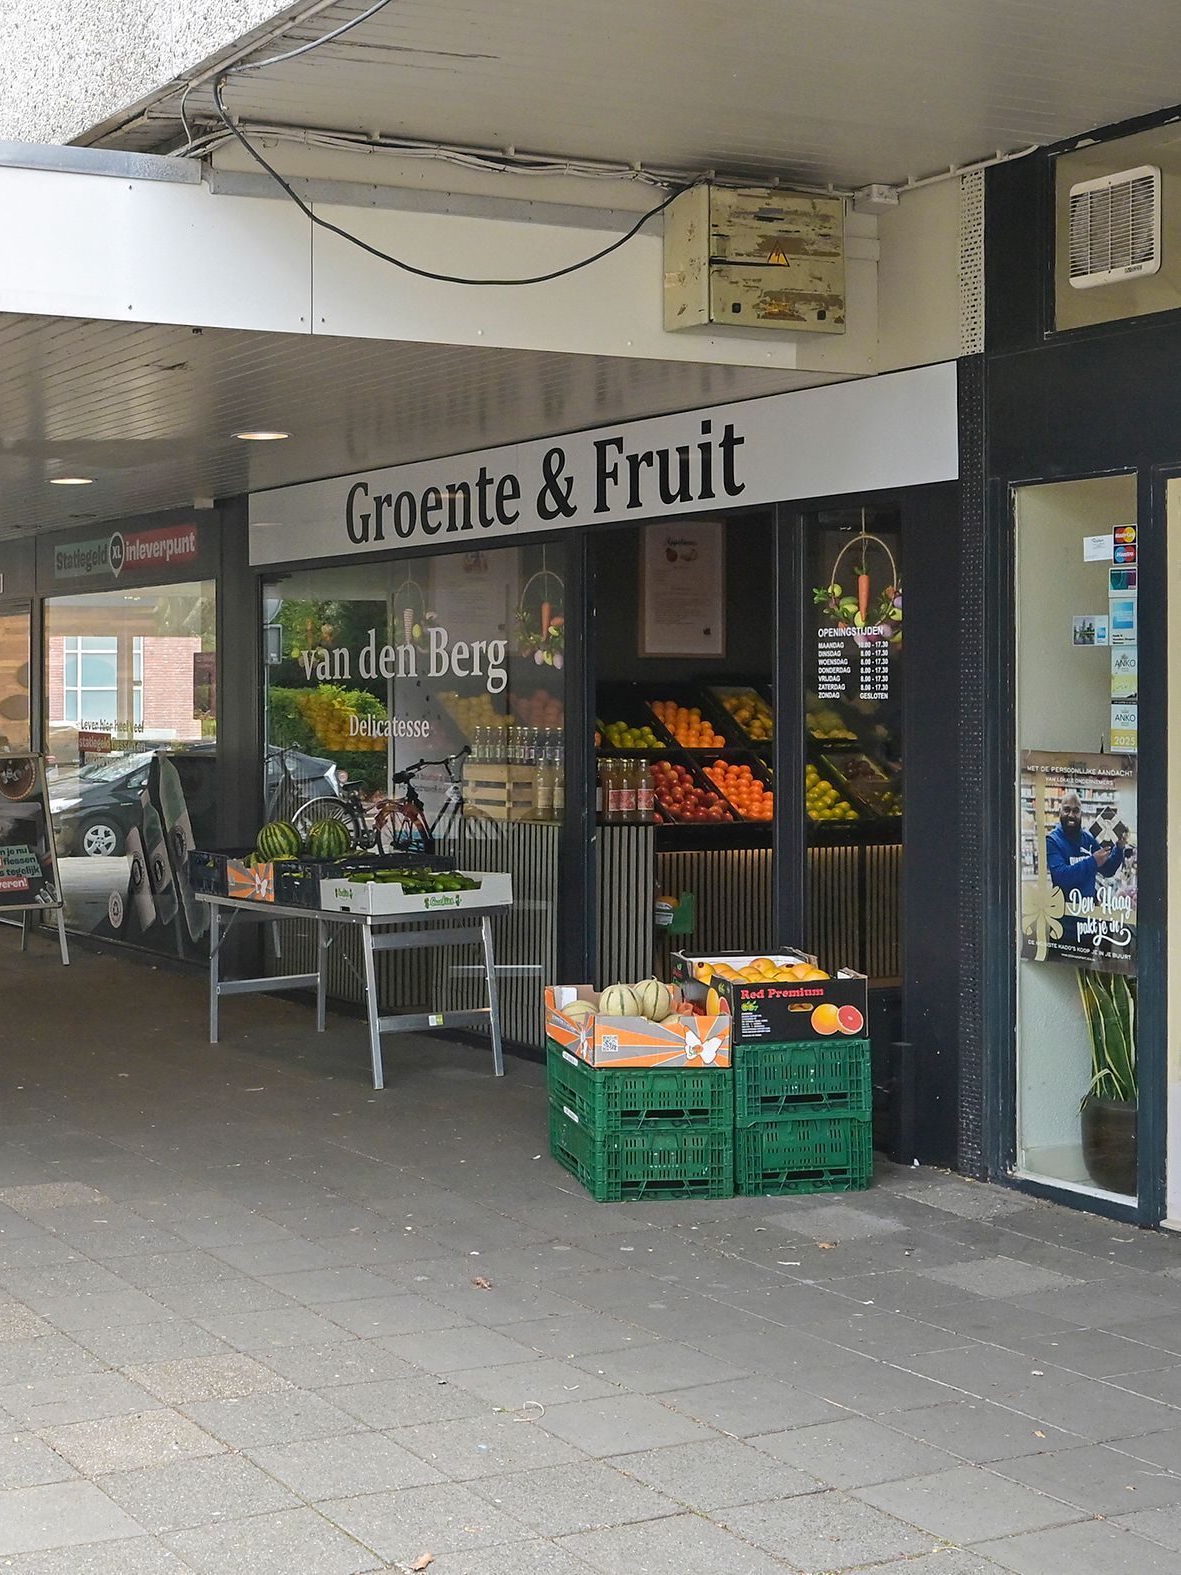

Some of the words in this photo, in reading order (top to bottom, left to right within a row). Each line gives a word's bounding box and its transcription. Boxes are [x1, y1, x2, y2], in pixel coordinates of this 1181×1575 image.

[346, 467, 520, 545] Groente
[536, 447, 578, 521] &
[593, 419, 746, 514] Fruit
[56, 545, 108, 573] Statiegeld
[111, 545, 122, 560] XL
[125, 531, 196, 561] inleverpunt
[818, 626, 884, 637] OPENINGSTIJDEN
[301, 646, 352, 681] van
[359, 628, 418, 680] den
[427, 627, 509, 694] Berg
[1114, 660, 1136, 668] ANKO
[1114, 714, 1136, 722] ANKO
[349, 714, 430, 738] Delicatesse
[1114, 737, 1135, 746] 2025
[1050, 766, 1097, 776] PERSOONLIJKE
[6, 848, 15, 857] je
[3, 856, 36, 866] flessen
[7, 866, 40, 878] tegelijk
[1068, 888, 1096, 916] Den
[1096, 886, 1133, 920] Haag
[1076, 916, 1098, 944] pakt
[740, 990, 765, 1000] Red
[768, 988, 824, 999] Premium
